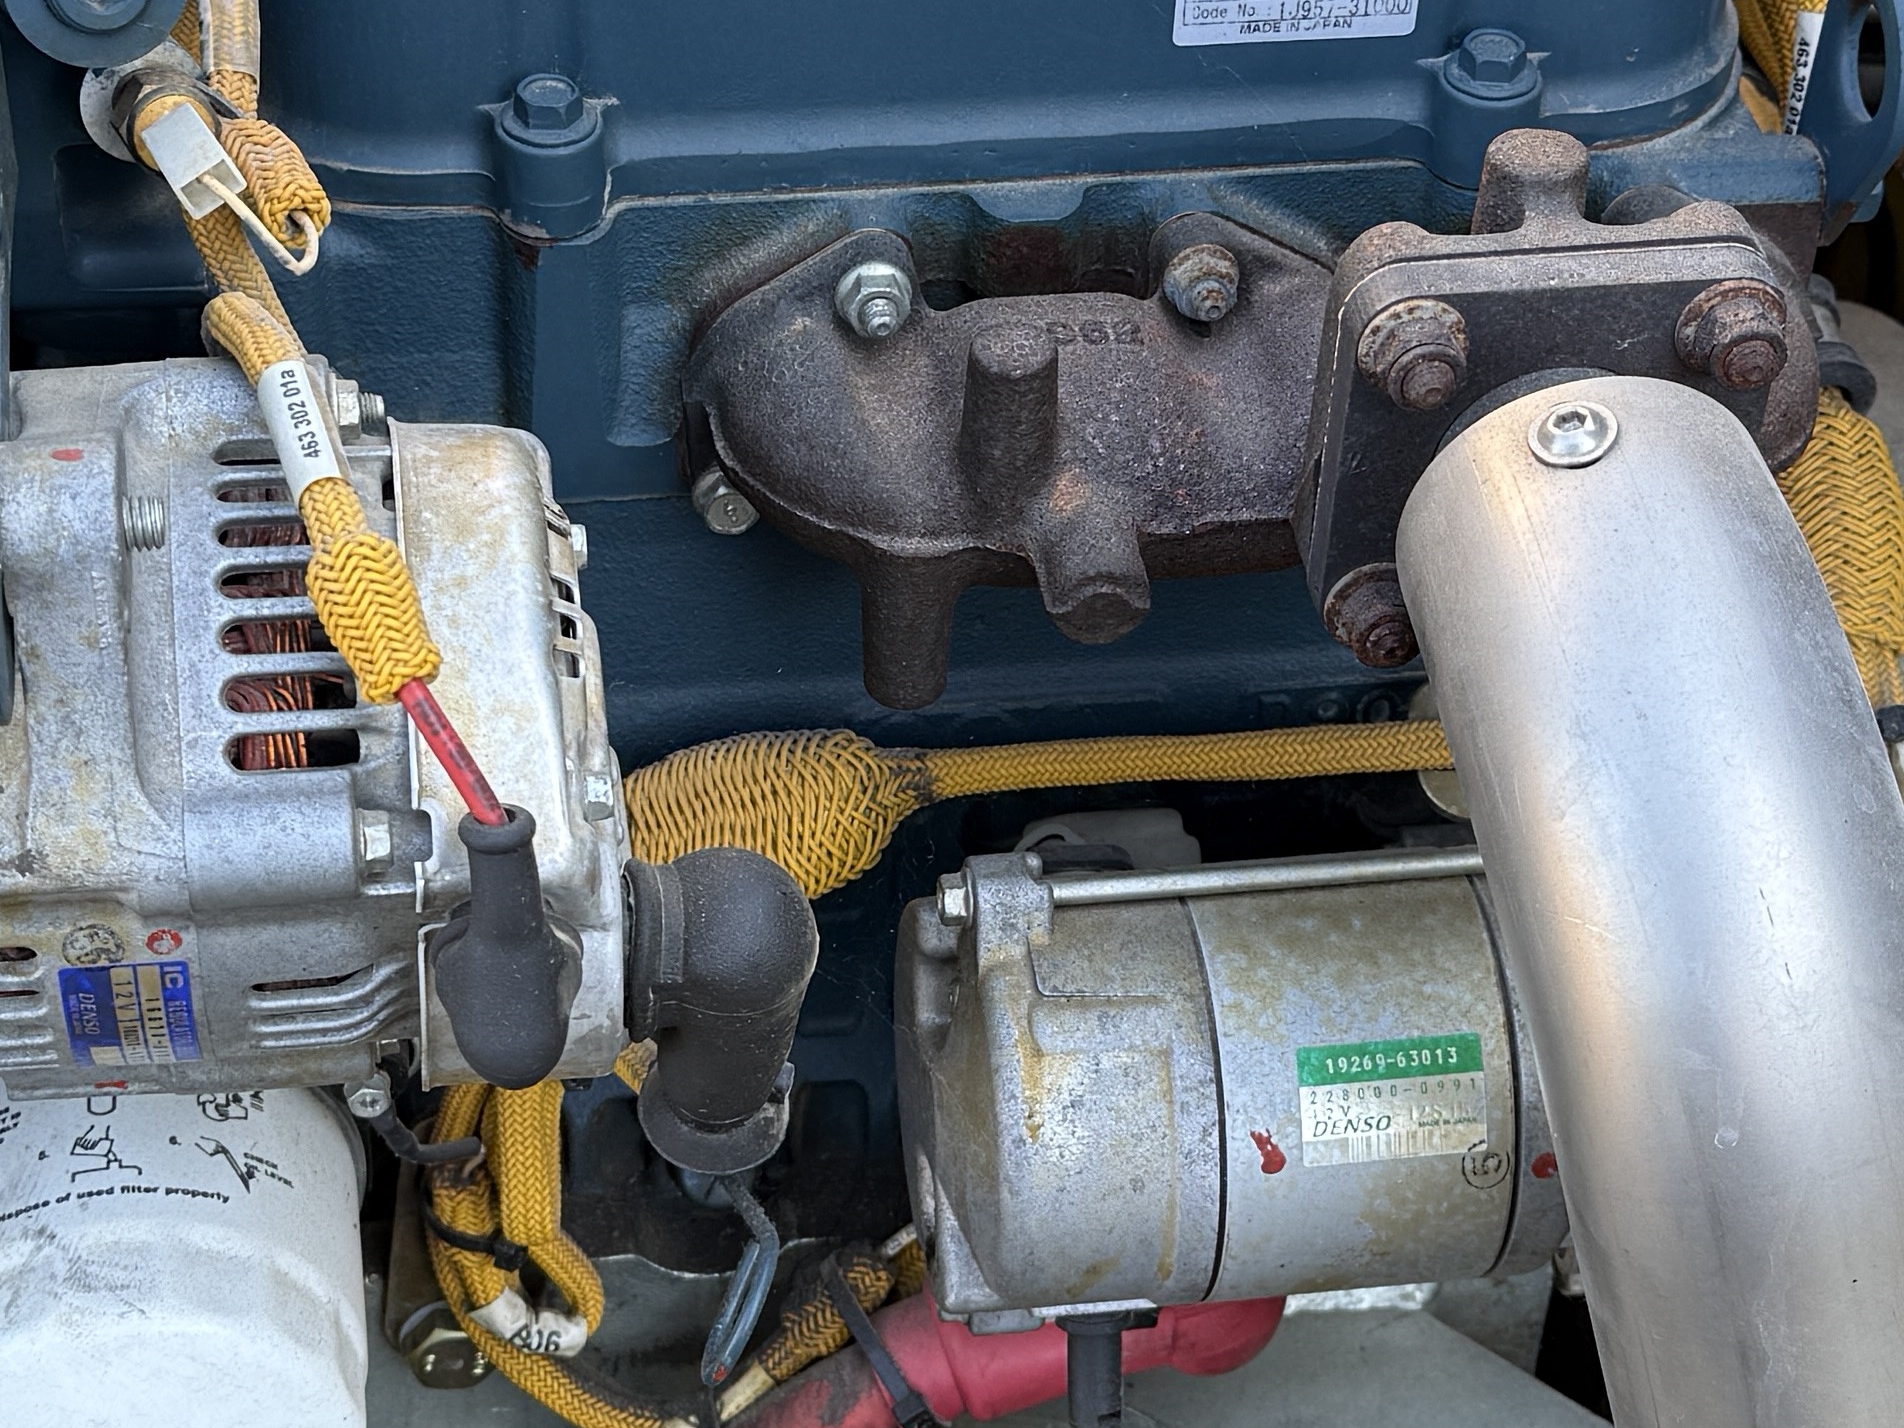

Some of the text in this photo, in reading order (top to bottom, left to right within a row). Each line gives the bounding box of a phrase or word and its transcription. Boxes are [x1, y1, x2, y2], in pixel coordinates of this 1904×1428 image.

[1193, 3, 1228, 20] Code
[1239, 20, 1281, 35] MADE
[1285, 20, 1300, 33] IN
[1795, 37, 1811, 69] 463
[1789, 71, 1807, 103] 302
[279, 369, 322, 458] 463 302 01a
[162, 965, 184, 989] IC
[113, 980, 136, 1013] 12V
[78, 992, 101, 1035] DENSO
[1325, 1047, 1458, 1074] 19269-63013
[1312, 1115, 1392, 1138] DENSO
[55, 1191, 72, 1205] of
[76, 1185, 116, 1200] used
[119, 1183, 161, 1195] filter
